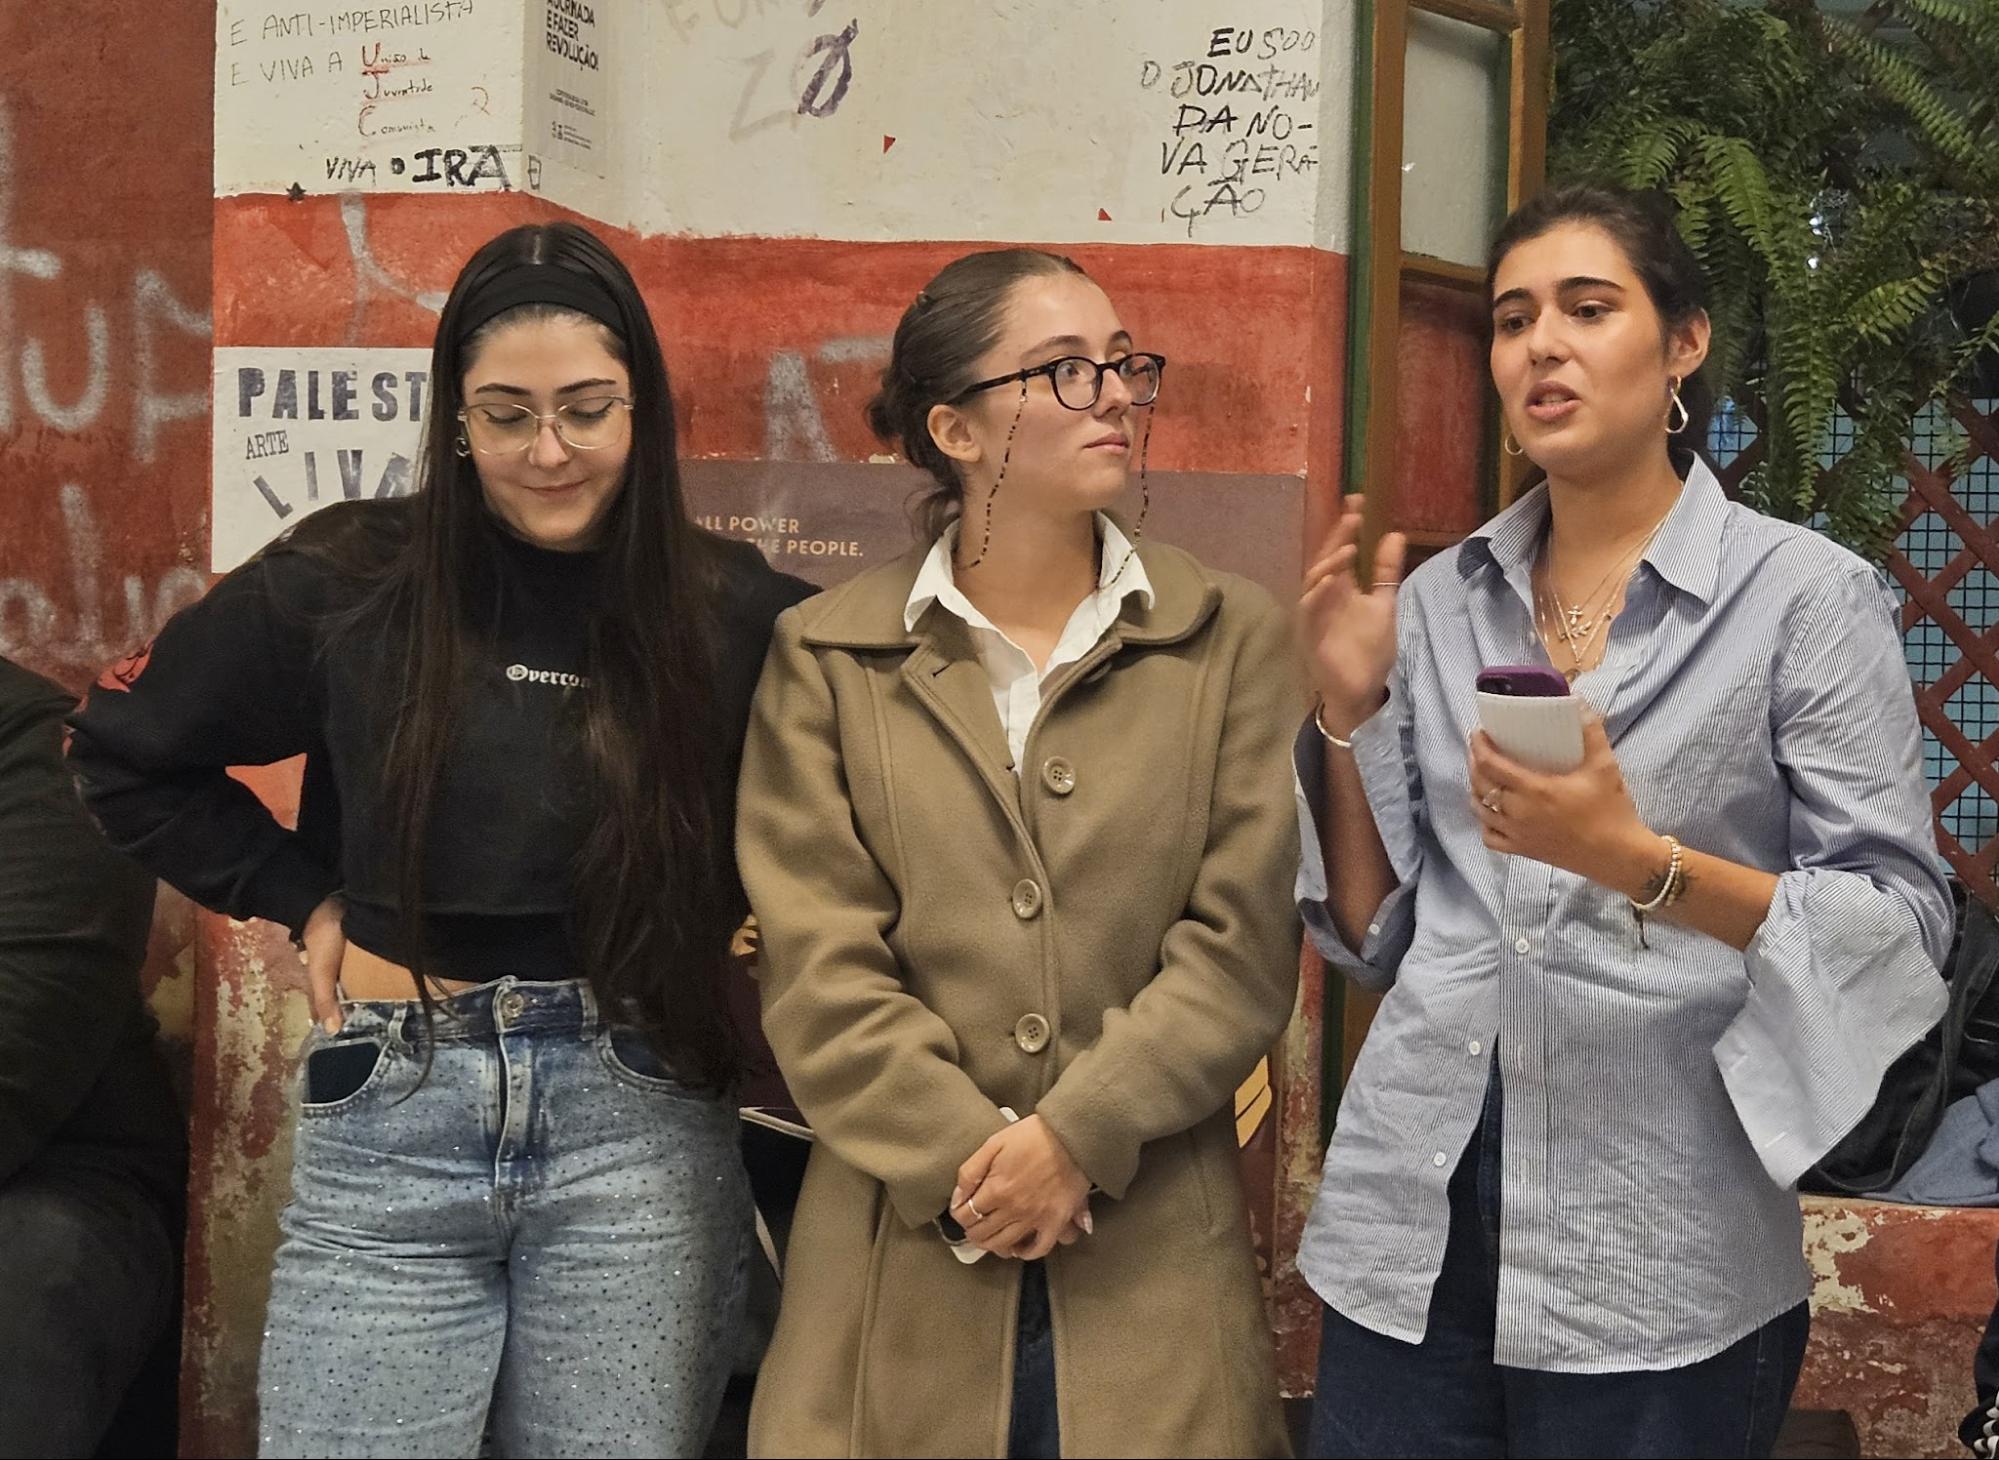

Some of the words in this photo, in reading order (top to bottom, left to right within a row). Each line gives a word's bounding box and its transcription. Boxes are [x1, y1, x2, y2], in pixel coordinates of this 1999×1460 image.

[231, 19, 247, 46] E
[262, 0, 473, 39] ANTI-IMPERIALISTA
[553, 13, 578, 41] FAZER
[546, 31, 598, 71] REVOLUÇÃO!
[1207, 27, 1253, 57] EU
[231, 62, 249, 86] E
[259, 56, 314, 82] VIVA
[328, 51, 342, 73] A
[1173, 103, 1238, 136] DA
[1161, 137, 1207, 175] VA
[326, 157, 376, 186] VIVA
[246, 430, 289, 460] ARTE
[729, 516, 800, 533] POWER
[786, 540, 863, 557] PEOPLE.
